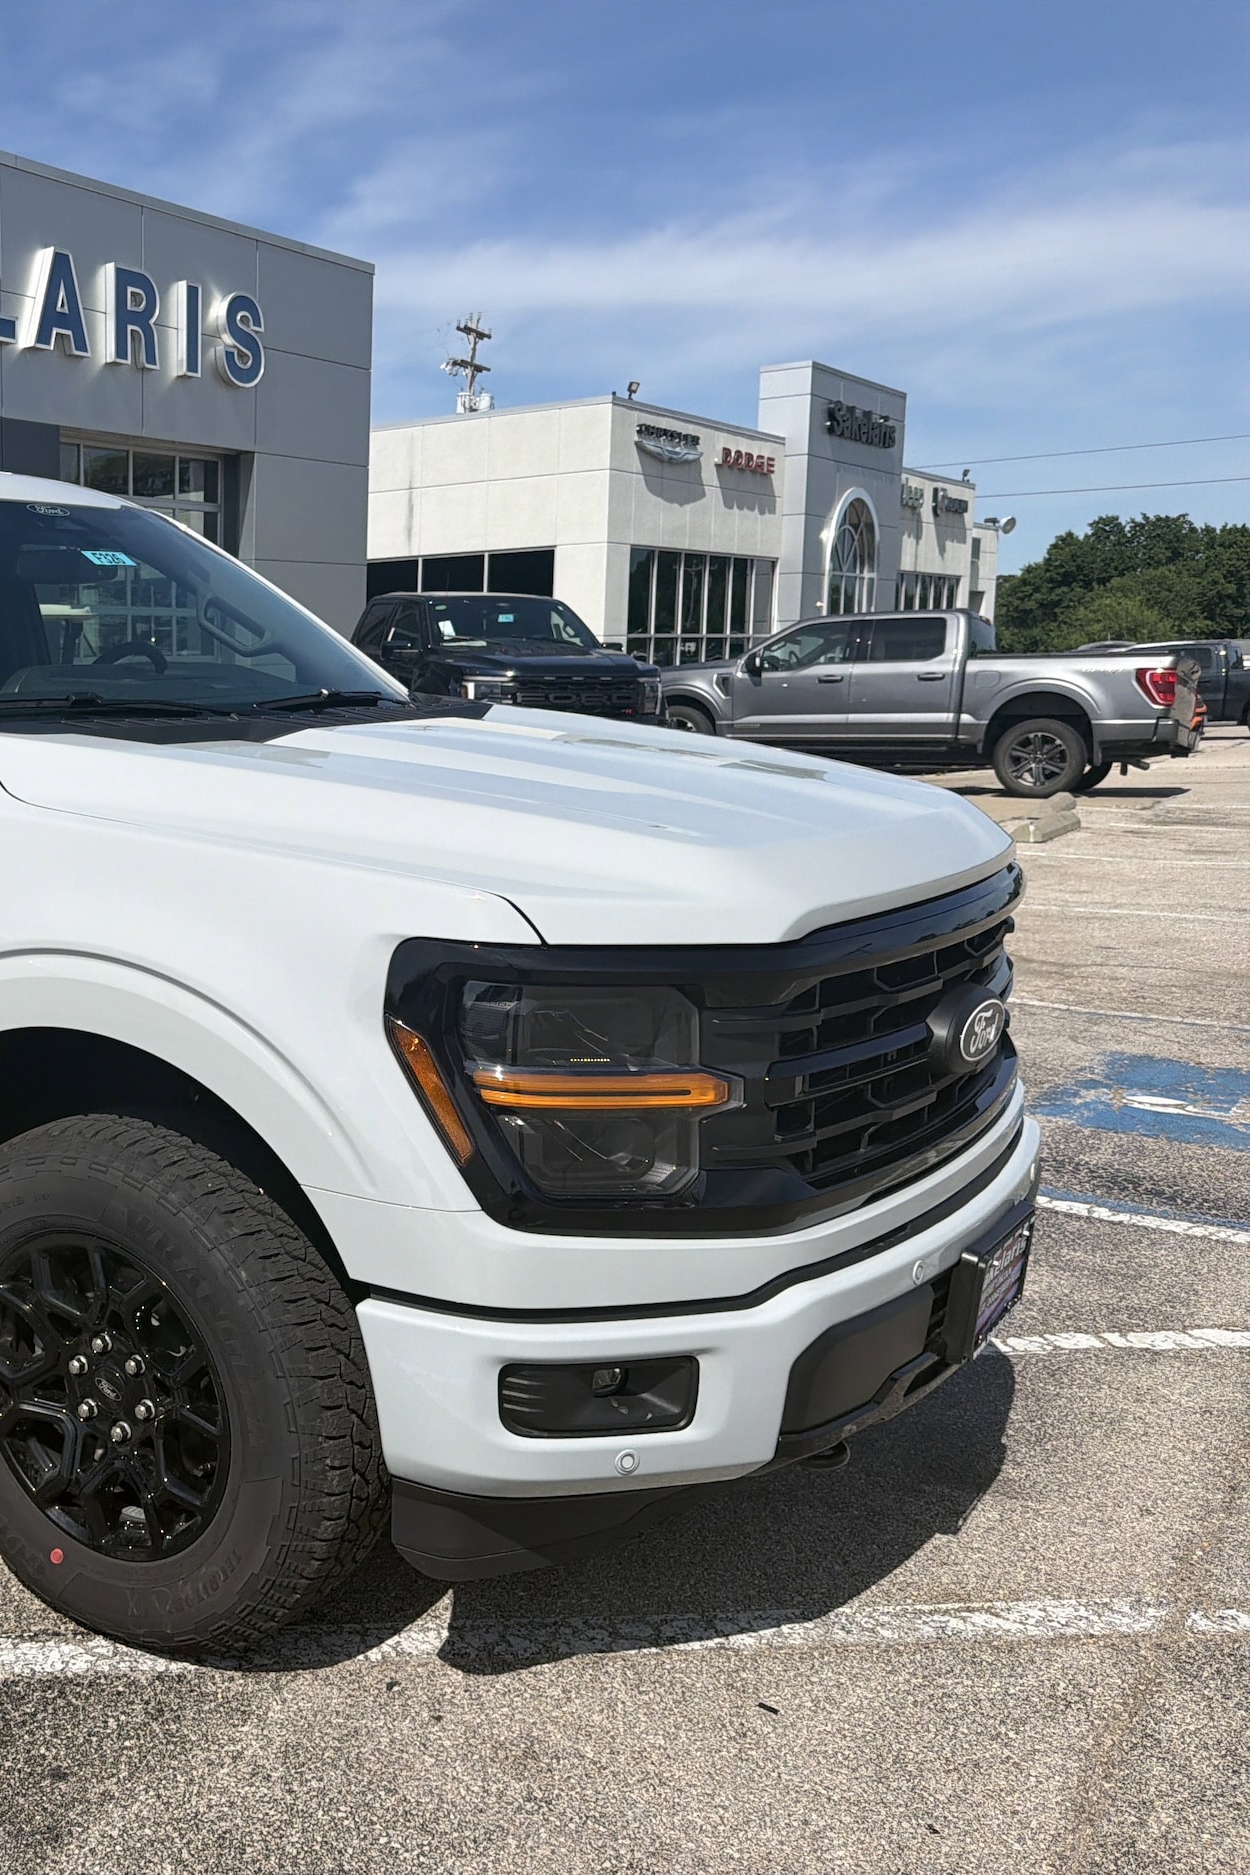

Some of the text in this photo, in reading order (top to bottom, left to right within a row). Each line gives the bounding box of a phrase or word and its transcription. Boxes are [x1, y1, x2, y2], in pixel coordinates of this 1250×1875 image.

[827, 401, 896, 449] Sakelaris
[722, 447, 776, 475] DODGE
[517, 692, 637, 706] FORD
[969, 1008, 999, 1054] Ford
